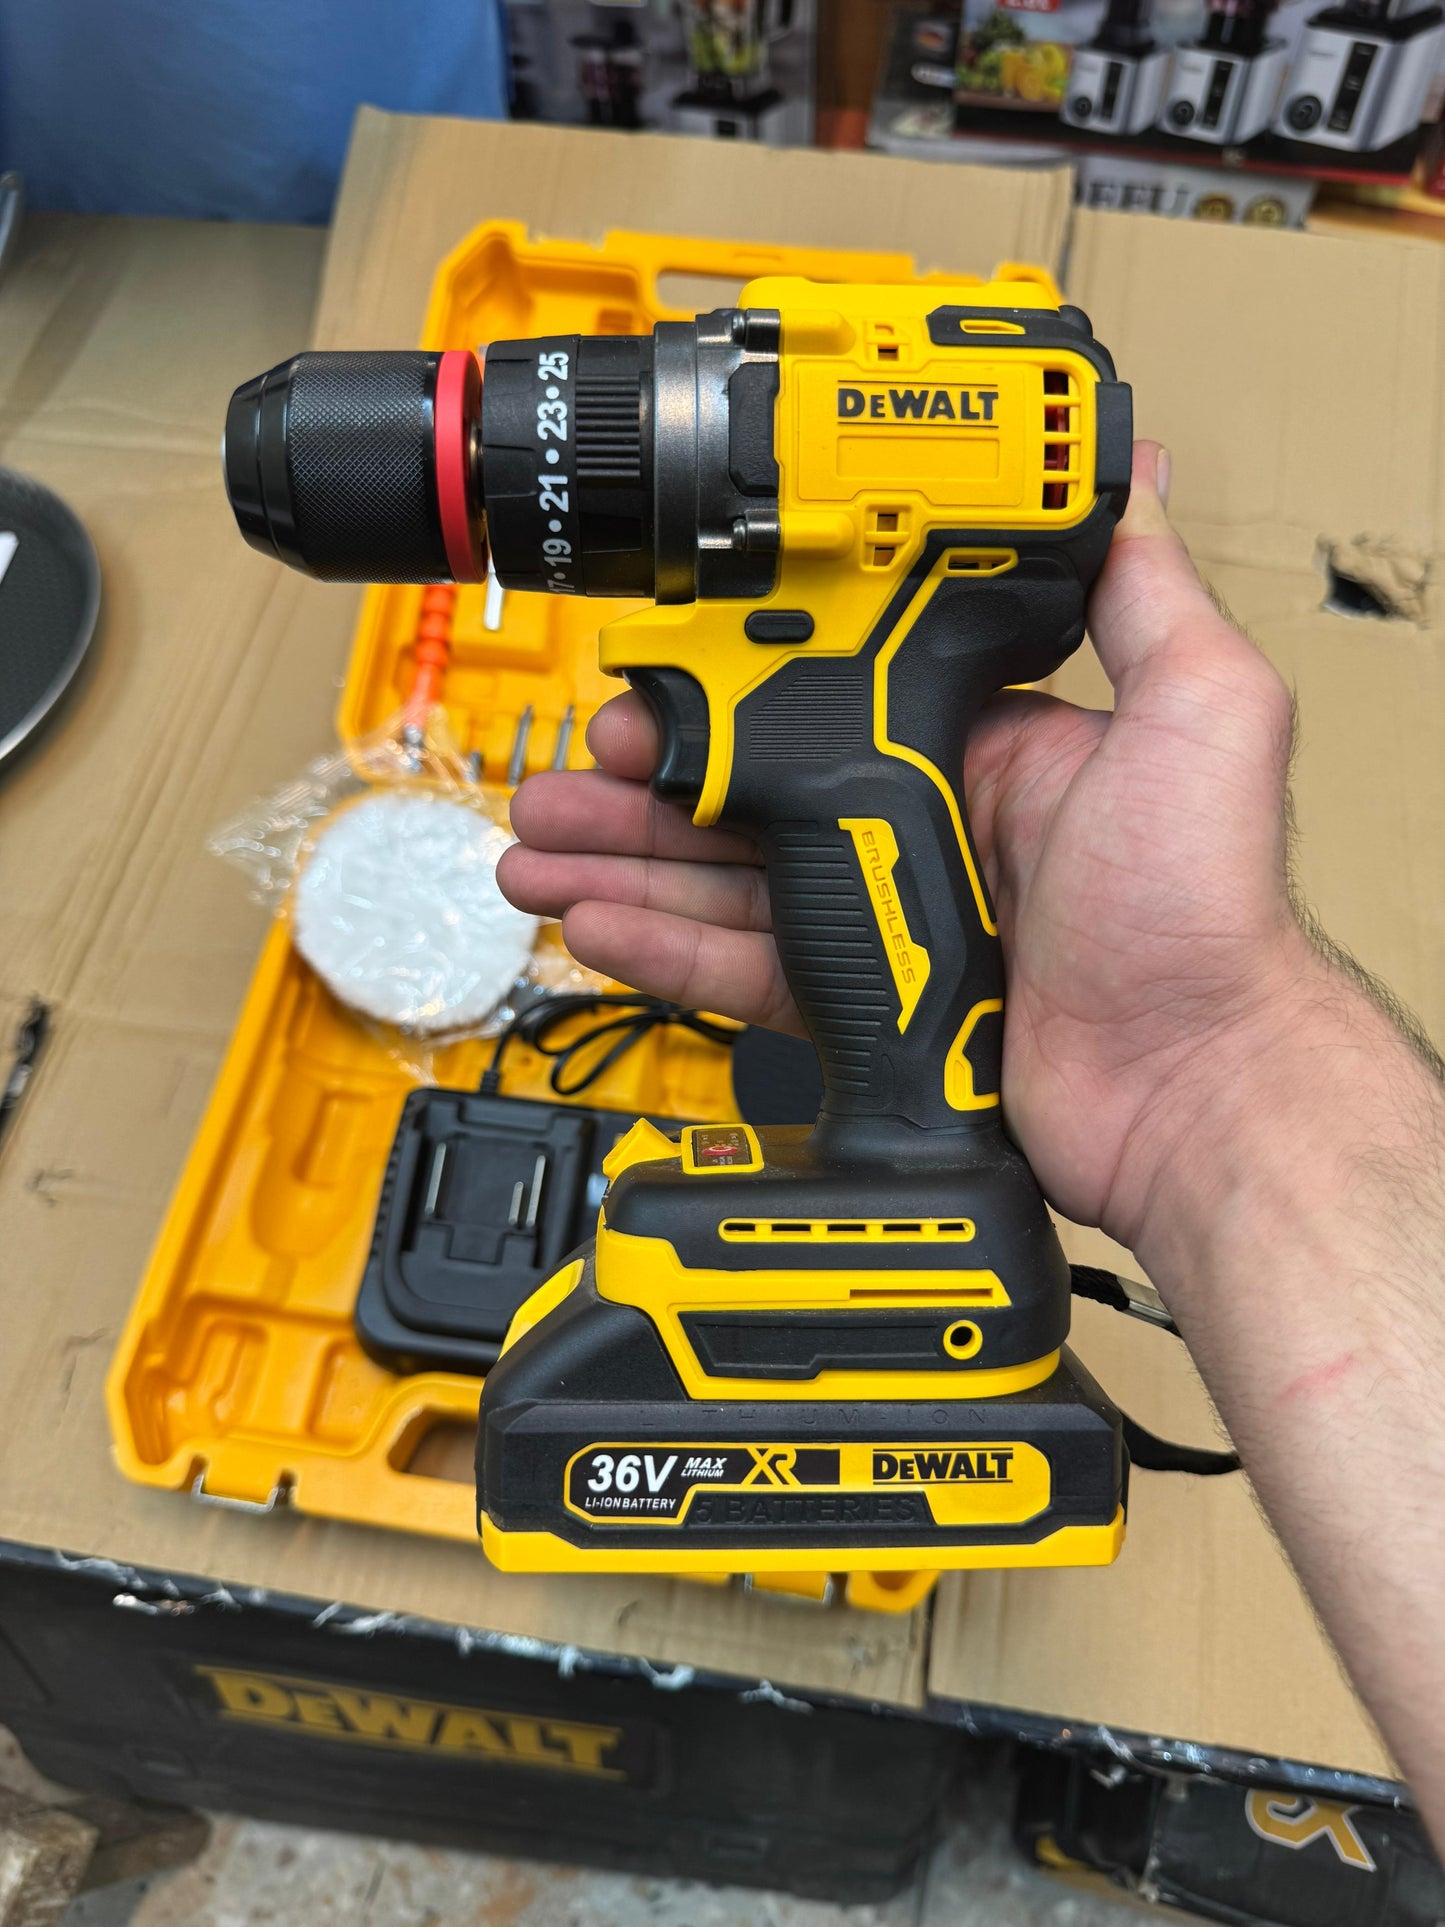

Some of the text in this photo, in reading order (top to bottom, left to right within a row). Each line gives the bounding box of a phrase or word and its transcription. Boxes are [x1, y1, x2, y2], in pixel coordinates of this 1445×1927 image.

[536, 351, 576, 593] 17 19 21 23 25
[861, 830, 916, 985] BRUSHLESS
[587, 1454, 678, 1493] 36V
[680, 1468, 724, 1478] LITHIUM
[684, 1457, 727, 1469] MAX
[740, 1447, 803, 1485] XR
[585, 1496, 677, 1511] LI-ION BATTERY
